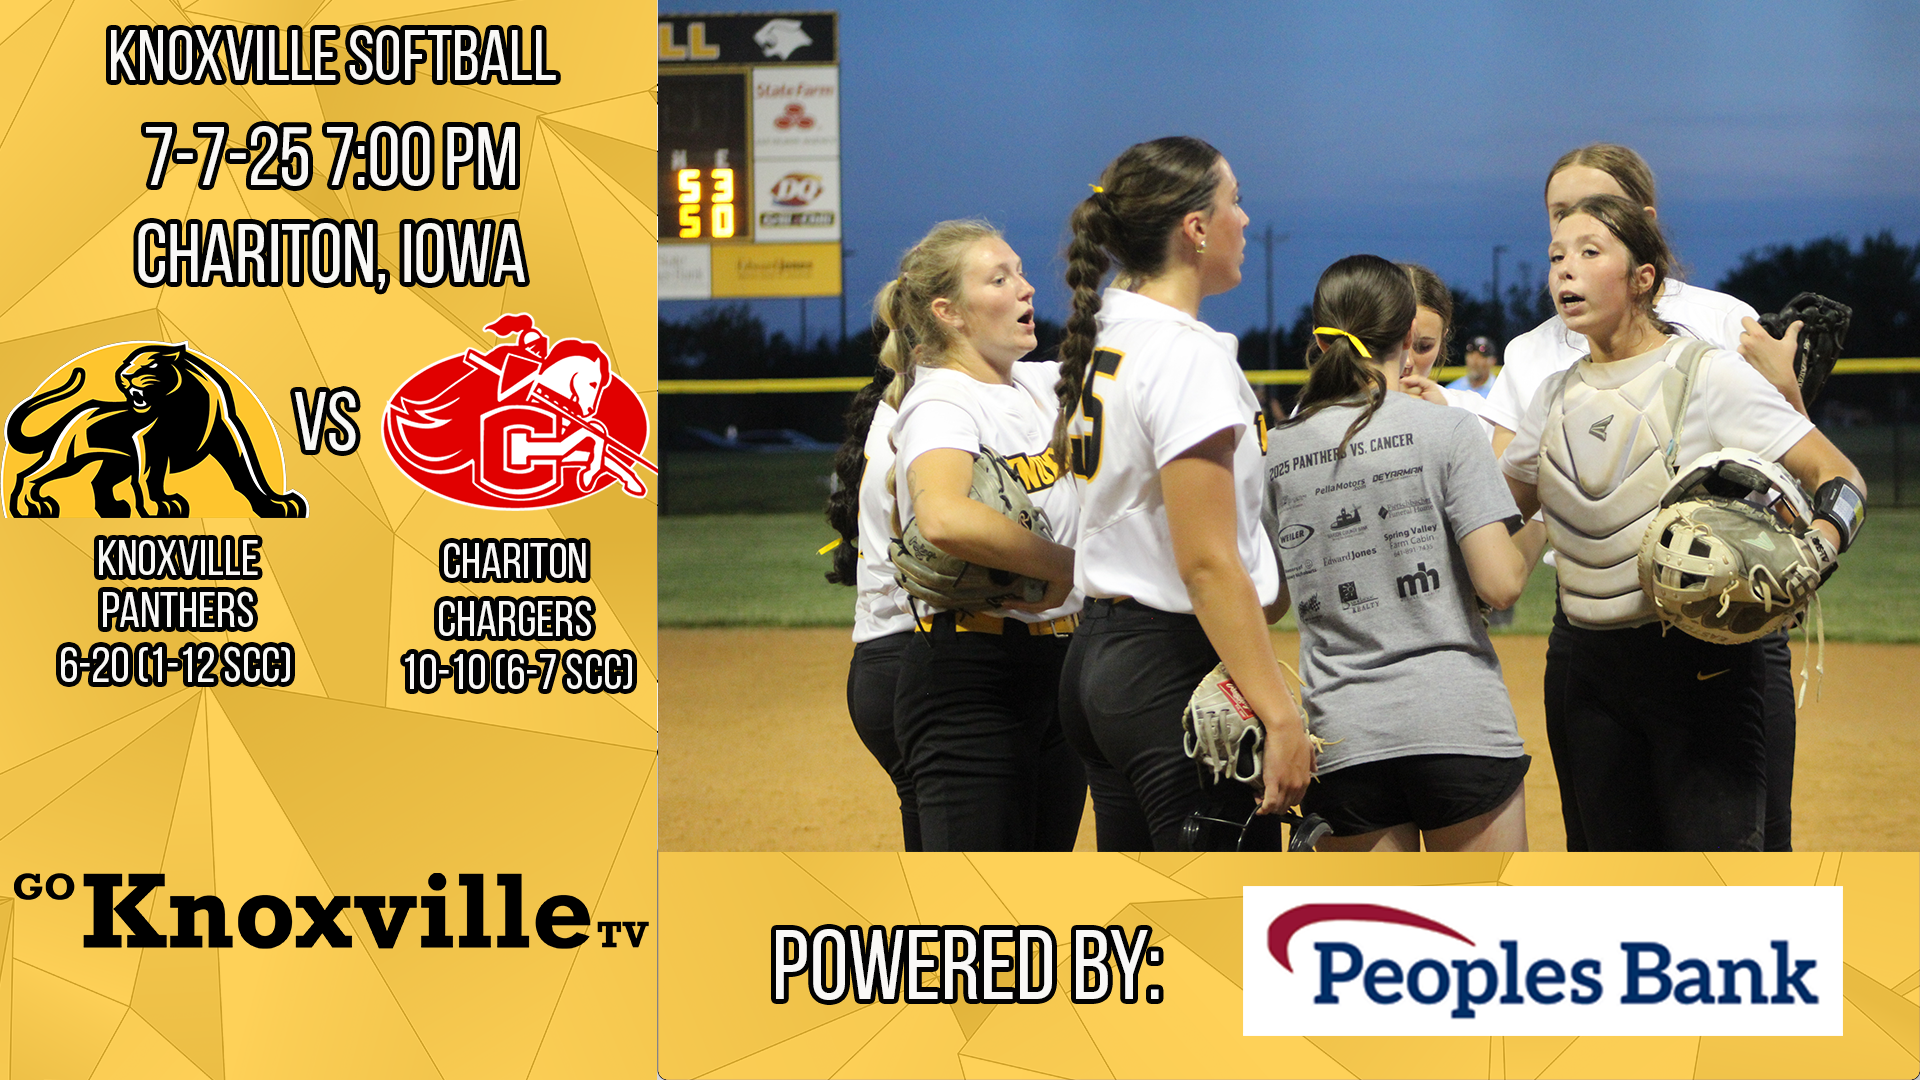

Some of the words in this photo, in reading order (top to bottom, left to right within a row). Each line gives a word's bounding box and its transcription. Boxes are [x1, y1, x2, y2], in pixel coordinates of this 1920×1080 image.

[678, 168, 701, 204] 5
[711, 168, 734, 203] 3
[678, 203, 701, 238] 5
[711, 203, 735, 238] 0
[1269, 460, 1290, 481] 2025
[1350, 442, 1367, 456] VS.
[1370, 433, 1414, 452] CANCER
[1372, 465, 1424, 482] DEYARMAN
[1315, 478, 1366, 496] PellaMotors
[1280, 529, 1305, 543] WEILER
[1383, 530, 1410, 542] Spring
[1410, 524, 1438, 535] Valley
[1390, 539, 1409, 549] Farm
[1410, 534, 1435, 545] Cabin
[1352, 600, 1380, 614] REALTY
